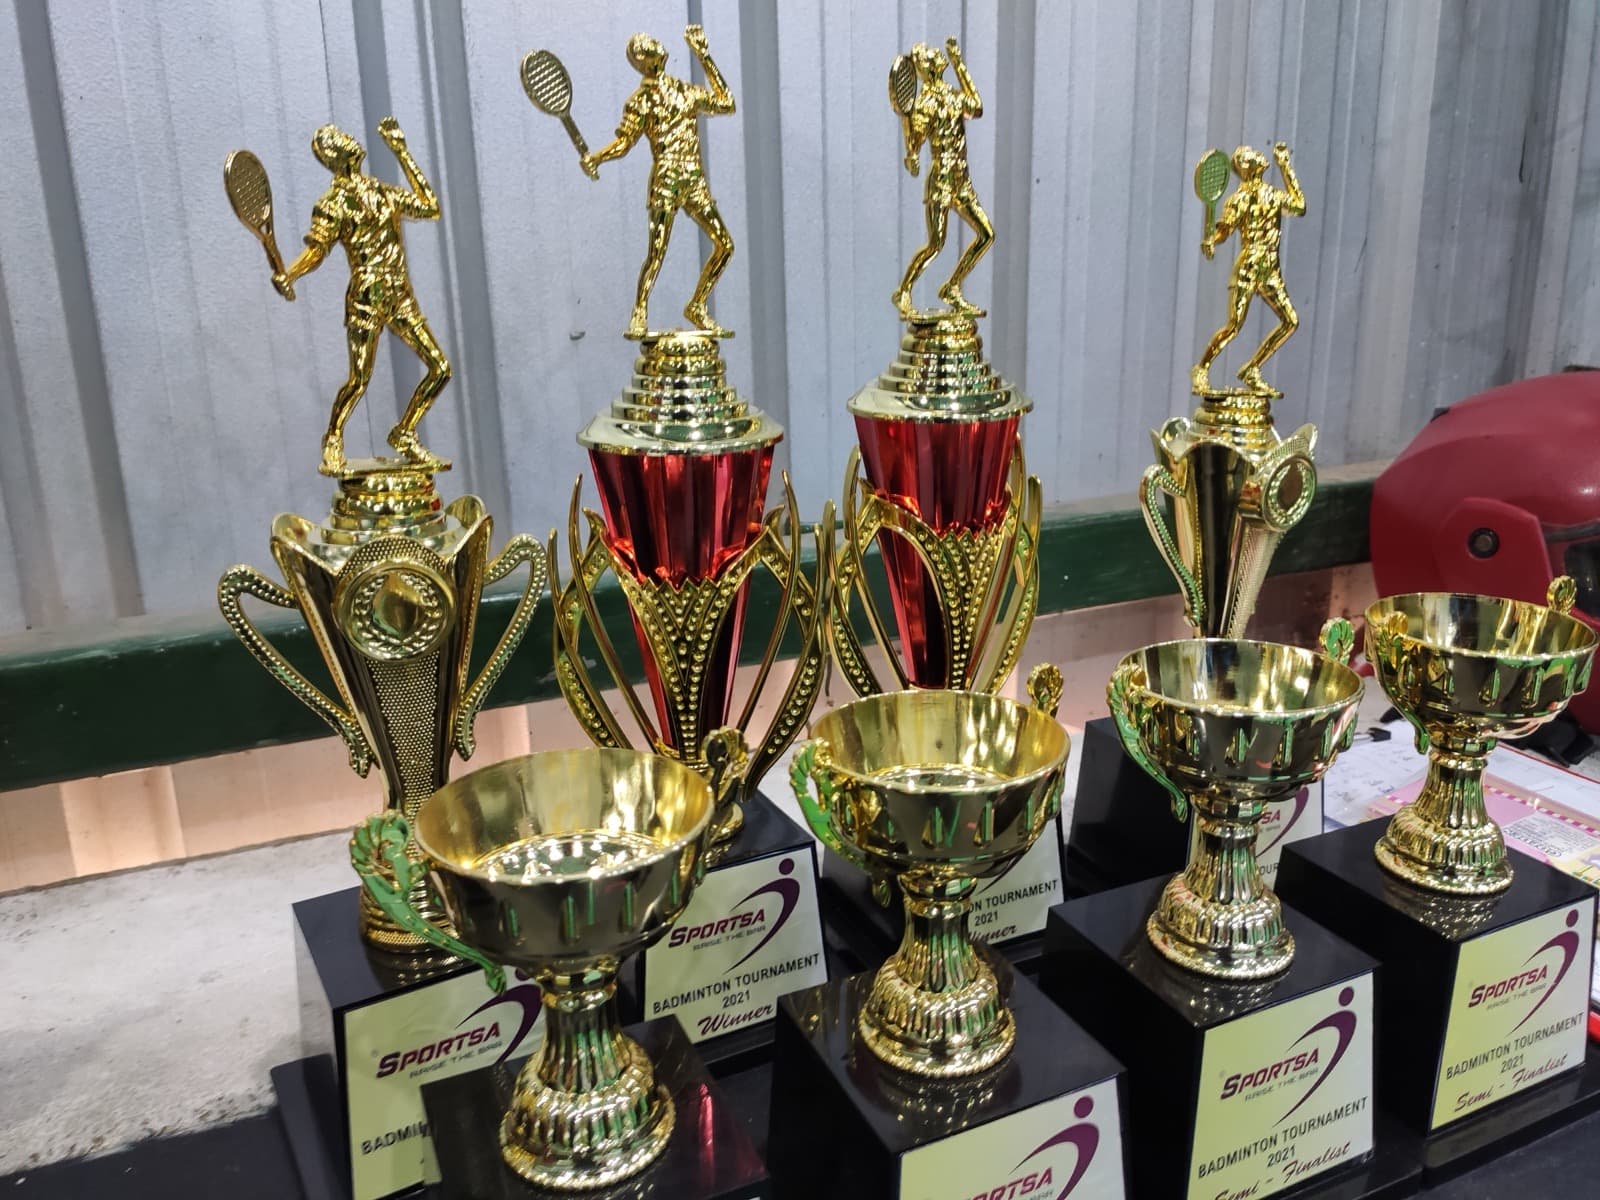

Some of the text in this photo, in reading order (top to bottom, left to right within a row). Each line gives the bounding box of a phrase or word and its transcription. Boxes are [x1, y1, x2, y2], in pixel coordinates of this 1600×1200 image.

[985, 879, 1058, 909] TOURNAMENT
[668, 908, 766, 948] SPORTSA
[968, 925, 1016, 942] inner
[974, 911, 998, 927] 2021
[653, 953, 820, 1014] BADMINTON TOURNAMENT
[723, 990, 751, 1009] 2021
[1468, 964, 1548, 1008] SPORTSA
[697, 1003, 774, 1036] Winner
[376, 1022, 501, 1079] SPORTSA
[1446, 1012, 1584, 1080] BADMINTON TOURNAMENT
[1500, 1054, 1525, 1074] 2021
[1220, 1048, 1319, 1100] SPORTSA
[1454, 1086, 1494, 1113] Semi
[1511, 1053, 1568, 1089] Finalist
[361, 1121, 427, 1156] BADMI
[1198, 1096, 1368, 1179] BADMINTON TOURNAMENT
[1266, 1145, 1297, 1168] 2021
[1282, 1141, 1351, 1184] Finalist
